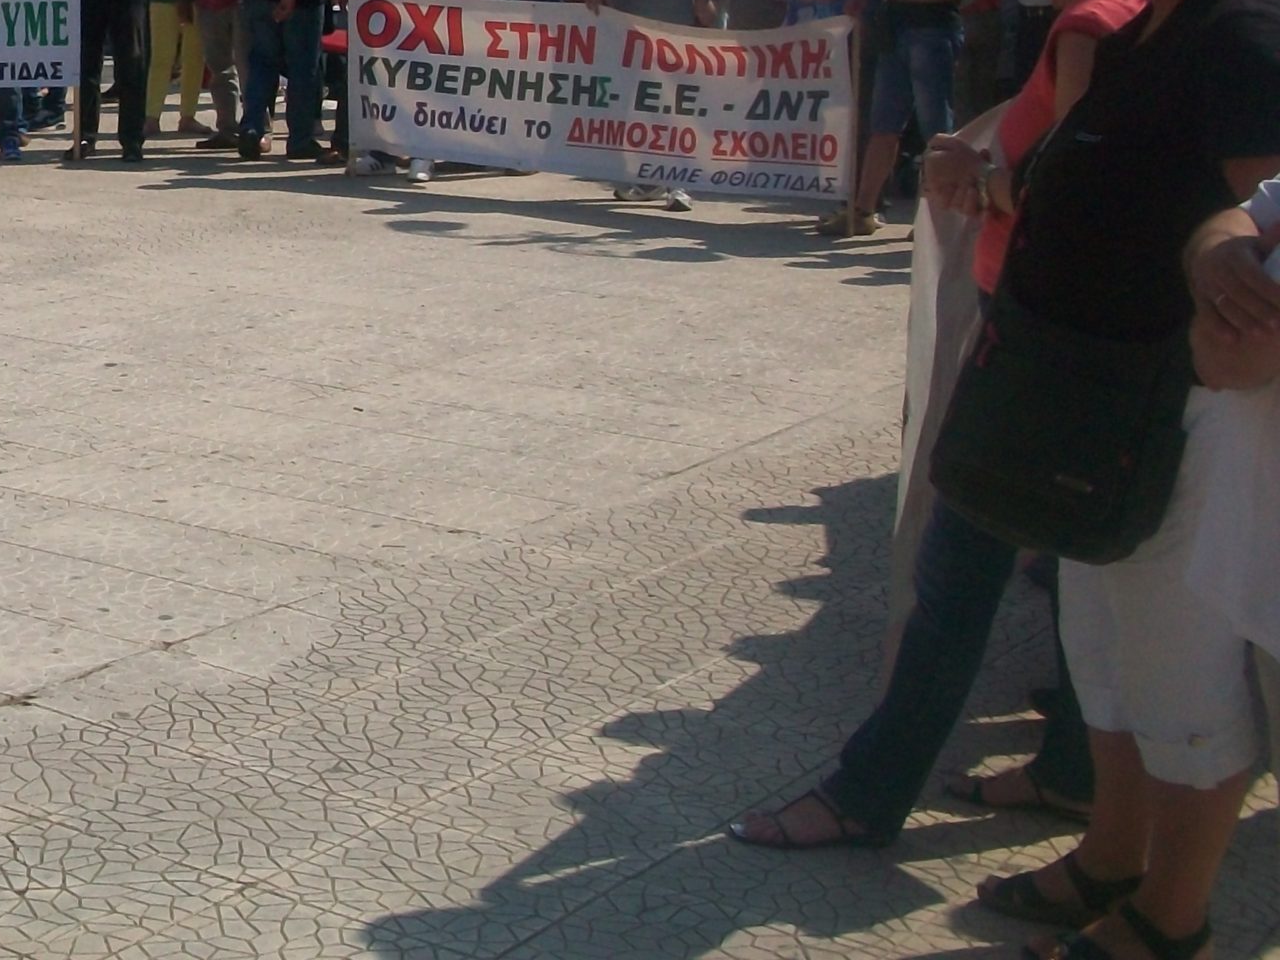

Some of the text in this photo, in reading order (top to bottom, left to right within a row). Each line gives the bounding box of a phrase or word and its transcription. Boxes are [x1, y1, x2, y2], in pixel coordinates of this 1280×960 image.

[356, 0, 464, 56] ΟΧΙ
[484, 21, 596, 65] ΣΤΗΝ
[634, 80, 707, 117] Ε.Ε.
[745, 89, 829, 121] ΔΝΤ
[413, 102, 506, 135] διαλύει
[524, 119, 551, 139] το
[567, 117, 697, 155] ΔΗΜΟΣΙΟ
[711, 129, 838, 162] ΣΧΟΛΕΙΟ
[638, 163, 838, 193] ΕΛΜΕ ΦΘΙΩΤΙΔΑΣ
